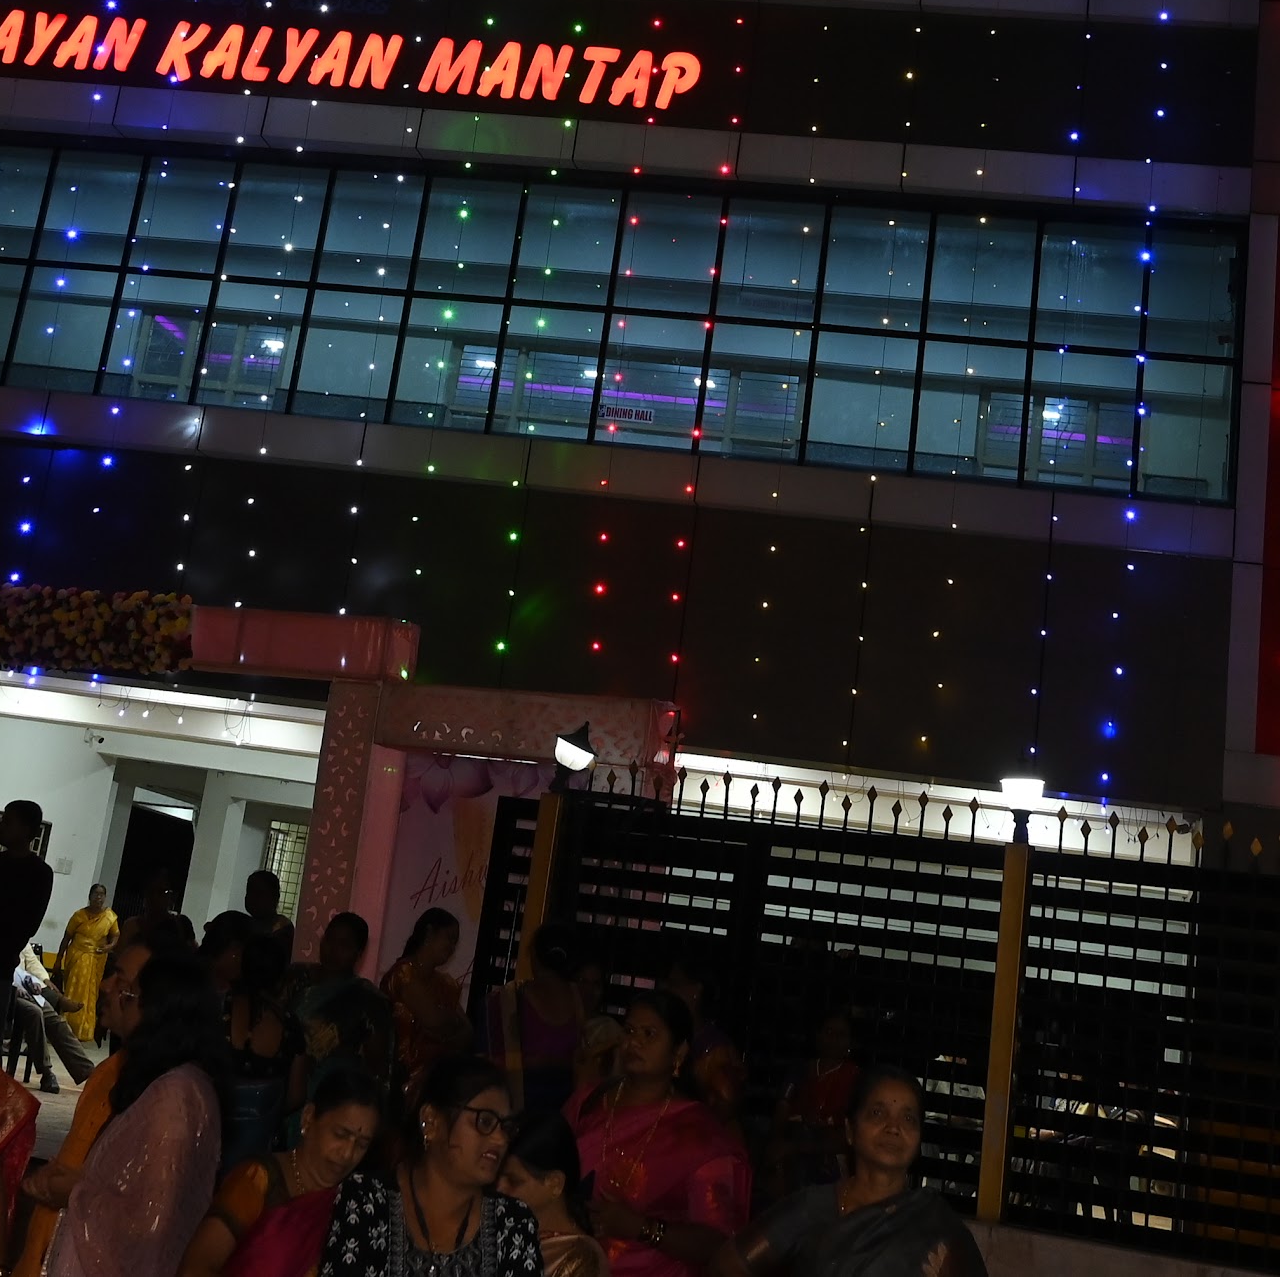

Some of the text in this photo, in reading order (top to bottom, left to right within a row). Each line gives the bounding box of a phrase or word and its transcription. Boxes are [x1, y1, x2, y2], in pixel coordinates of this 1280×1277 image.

[154, 19, 405, 91] KALYAN
[416, 36, 703, 111] MANTAP
[605, 407, 653, 422] DINING HALL
